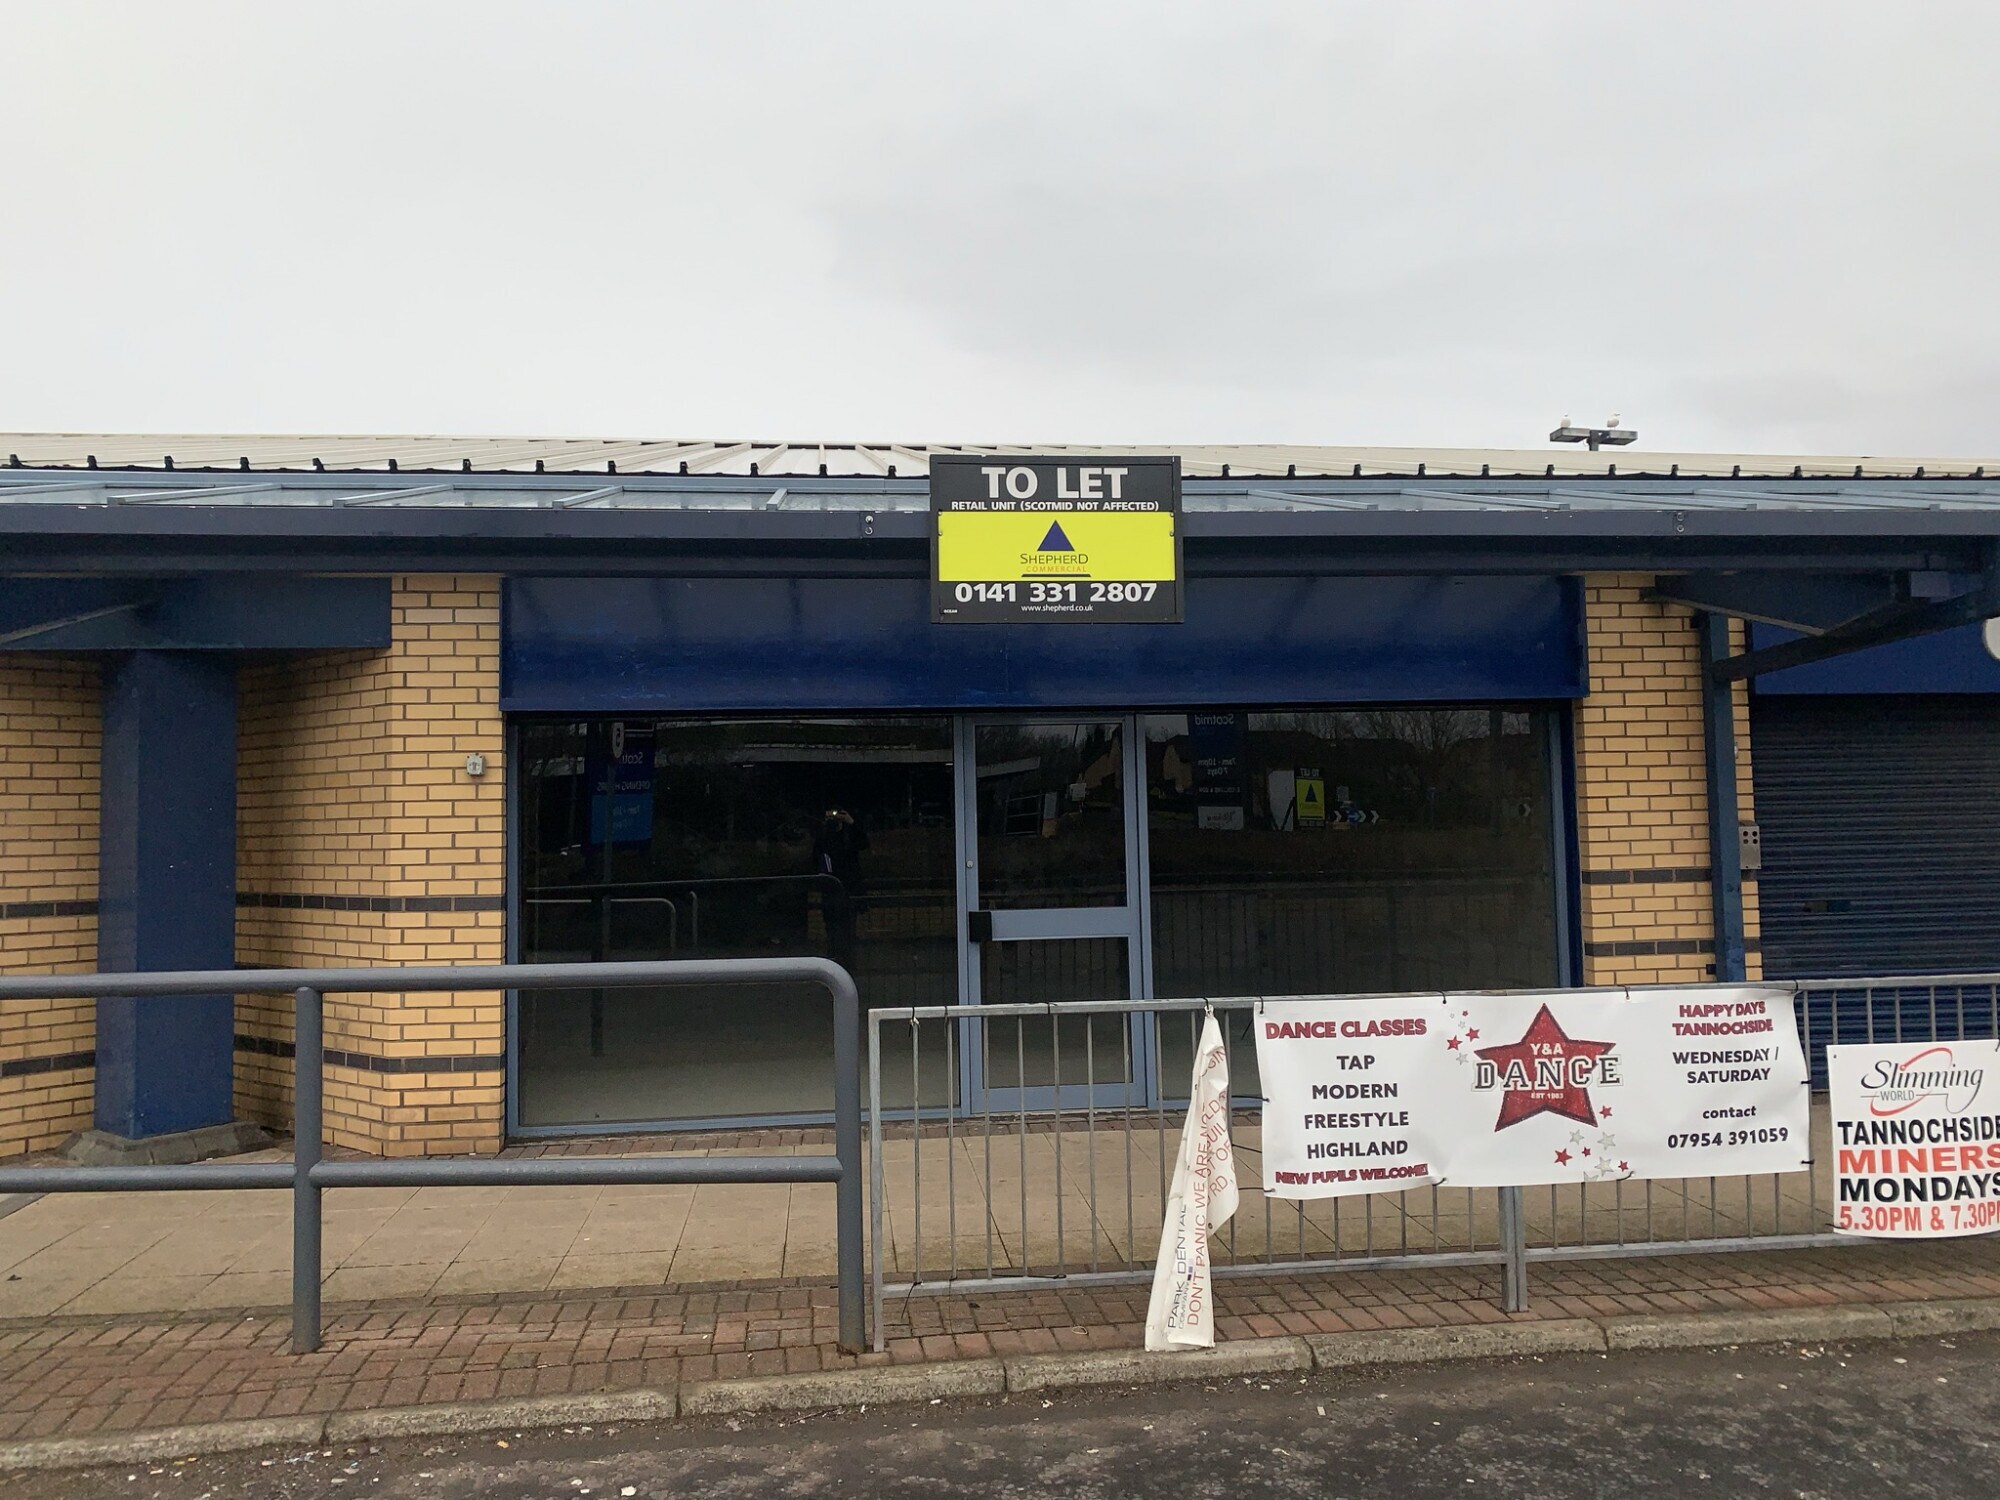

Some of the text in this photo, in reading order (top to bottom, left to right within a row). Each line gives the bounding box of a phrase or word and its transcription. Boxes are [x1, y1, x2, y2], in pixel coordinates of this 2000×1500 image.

[981, 467, 1128, 499] TO LET
[952, 501, 1159, 511] RETAIL UNIT (SCOTMID NOT AFFECTED)
[1020, 554, 1088, 565] SHEPHERD
[955, 583, 1157, 602] 0141 331 2807
[1021, 604, 1094, 613] www.shepherd.co.uk
[1679, 1000, 1766, 1018] HAPPY DAYS
[1265, 1018, 1428, 1040] DANCE CLASSES
[1672, 1018, 1774, 1036] TANNOCHSIDE
[1530, 1042, 1563, 1056] Y&A
[1672, 1048, 1770, 1065] WEDNESDAY
[1336, 1055, 1376, 1070] TAP
[1474, 1054, 1622, 1092] DANCE
[1687, 1068, 1771, 1084] SATURDAY
[1312, 1083, 1398, 1100] MODERN
[1861, 1060, 1984, 1112] Slimming
[1531, 1092, 1545, 1100] EST
[1880, 1090, 1915, 1101] WORLD
[1304, 1111, 1409, 1129] FREESTYLE
[1702, 1106, 1757, 1119] contact
[1668, 1127, 1789, 1149] 07954 391059
[1307, 1140, 1408, 1159] HIGHLAND
[1195, 1142, 1208, 1178] ARE
[1839, 1144, 2000, 1174] MINERS
[1276, 1171, 1310, 1185] NEW
[1312, 1168, 1358, 1184] PUPILS
[1194, 1182, 1206, 1209] WE
[1840, 1206, 1922, 1232] 5.30PM
[1930, 1206, 1945, 1230] &
[1194, 1214, 1206, 1267] PANIC
[1168, 1204, 1187, 1328] PARK DENTAL
[1187, 1272, 1204, 1326] DON'T
